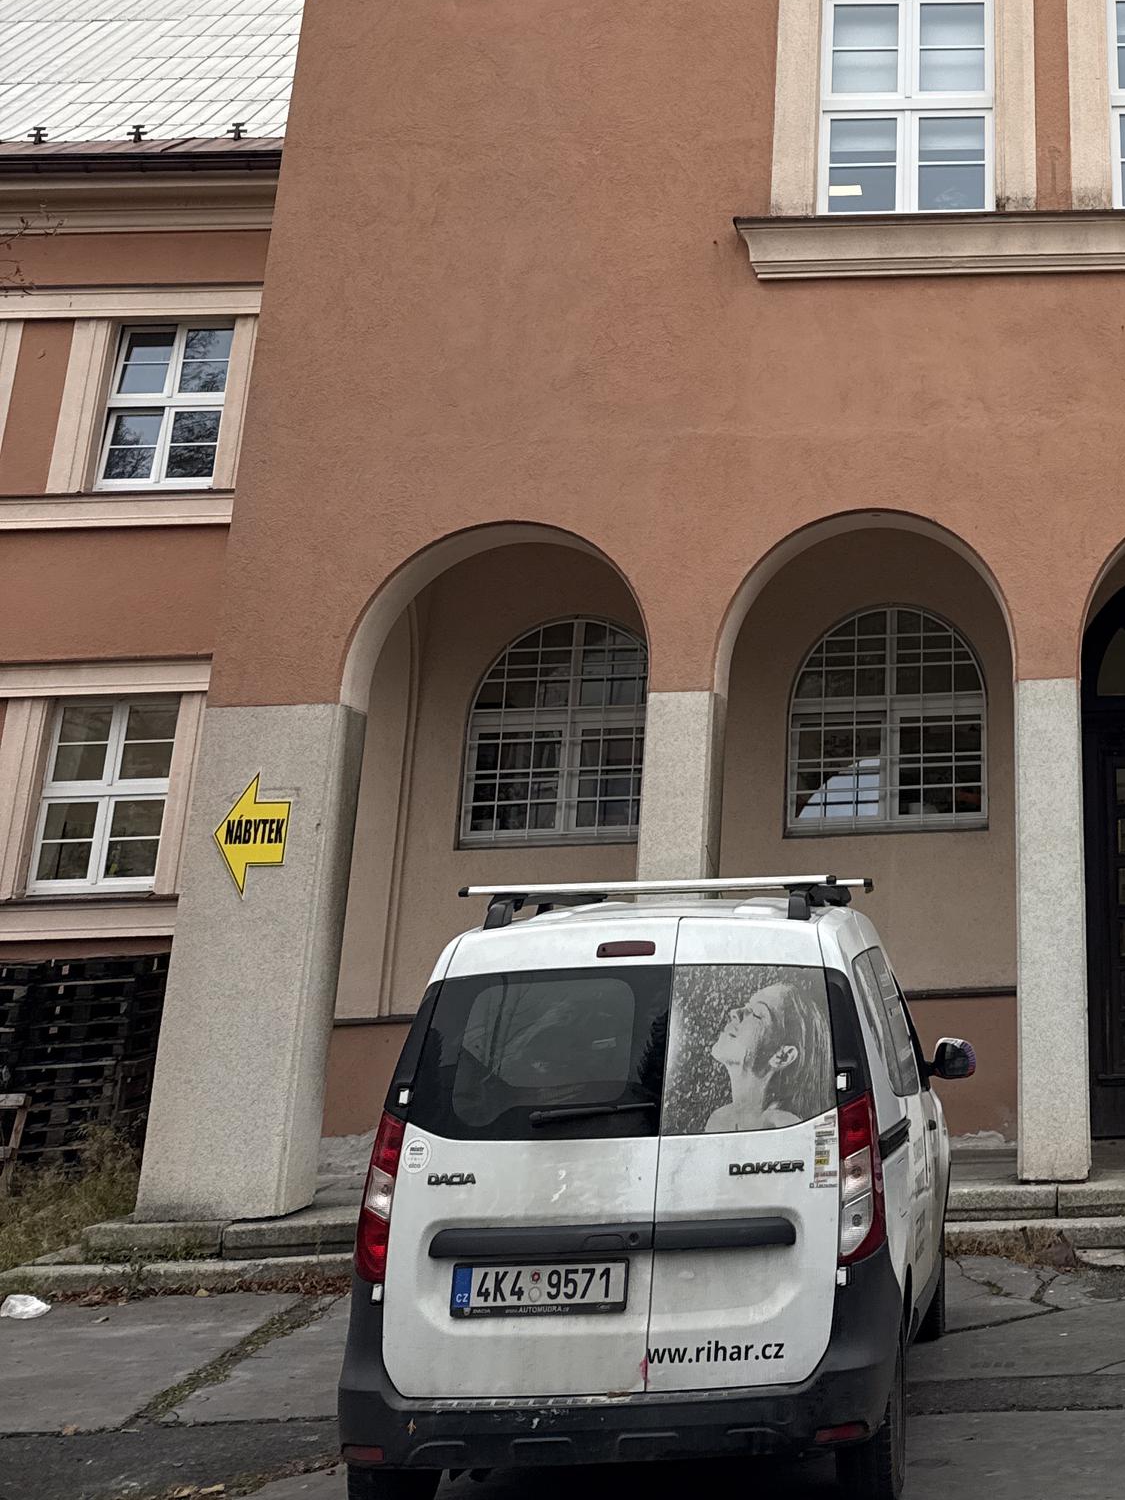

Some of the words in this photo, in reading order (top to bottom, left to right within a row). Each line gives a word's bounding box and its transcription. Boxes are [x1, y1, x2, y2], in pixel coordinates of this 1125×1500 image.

[224, 815, 285, 845] NÁBYTEK
[729, 1160, 804, 1175] DOKKER
[427, 1173, 476, 1186] DACIA
[456, 1293, 469, 1303] CZ
[476, 1271, 524, 1303] 4K4
[546, 1267, 611, 1300] 9571
